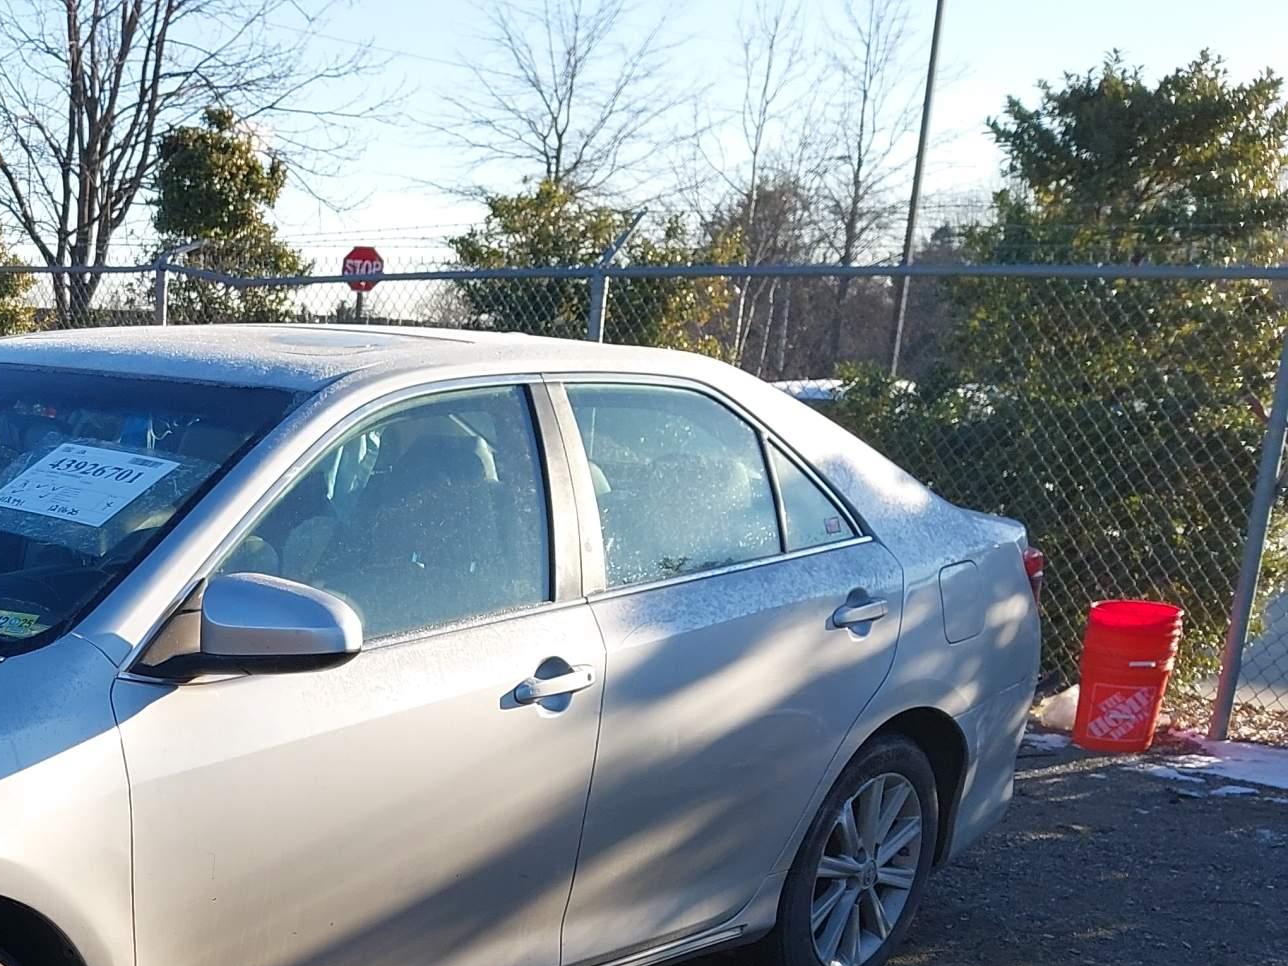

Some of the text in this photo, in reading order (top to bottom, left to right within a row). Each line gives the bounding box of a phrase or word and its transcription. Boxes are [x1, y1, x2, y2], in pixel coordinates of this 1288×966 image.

[344, 259, 382, 275] STOP
[49, 457, 144, 484] 43926701
[19, 618, 34, 629] 25
